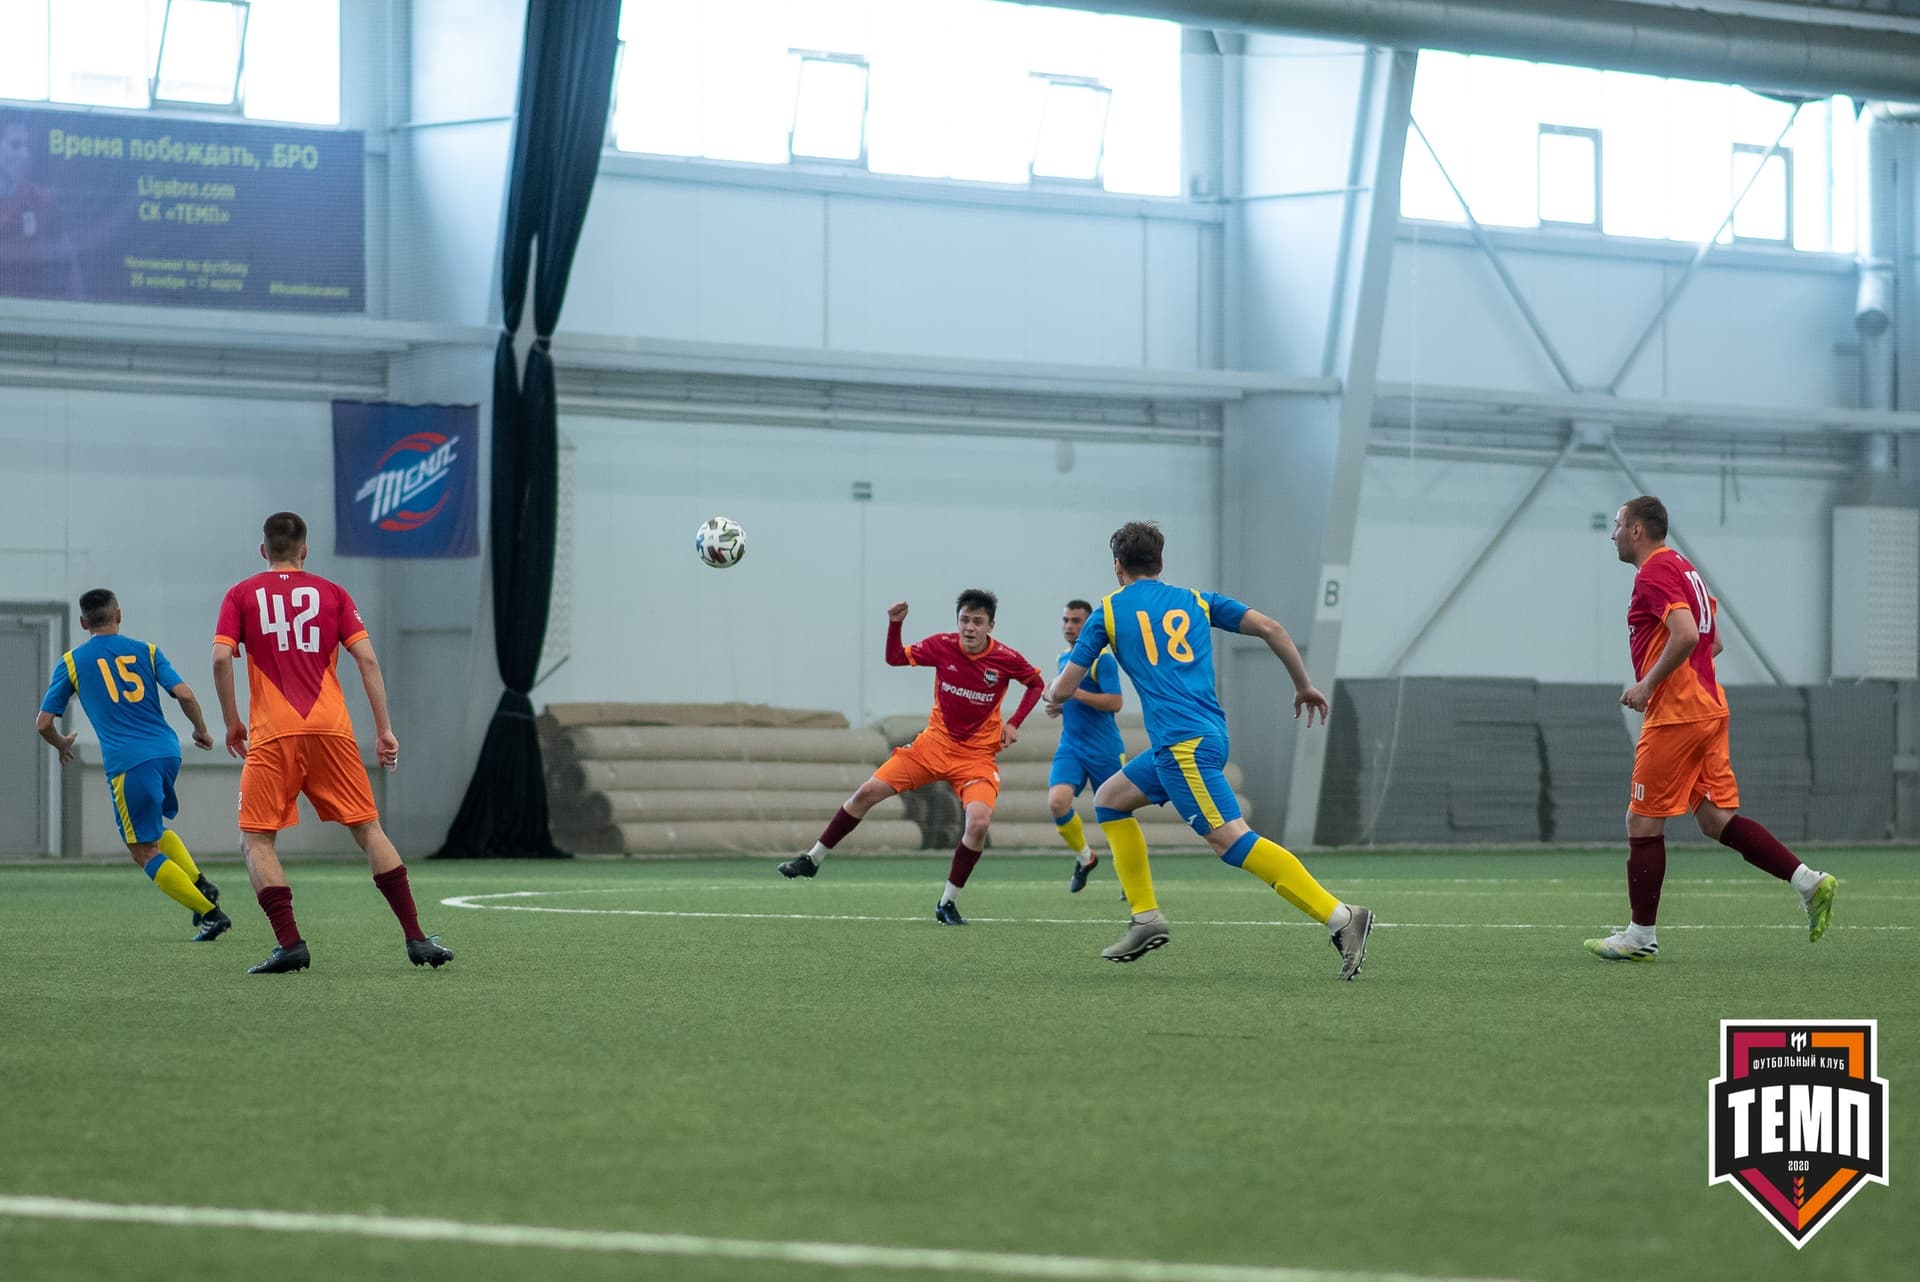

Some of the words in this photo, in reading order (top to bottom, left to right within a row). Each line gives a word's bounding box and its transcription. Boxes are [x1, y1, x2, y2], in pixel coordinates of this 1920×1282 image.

[50, 128, 123, 160] Время
[130, 135, 260, 172] побеждать,
[255, 586, 320, 653] 42
[1684, 570, 1712, 634] 10
[1136, 609, 1195, 666] 18
[97, 655, 145, 703] 15
[1634, 782, 1645, 801] 10
